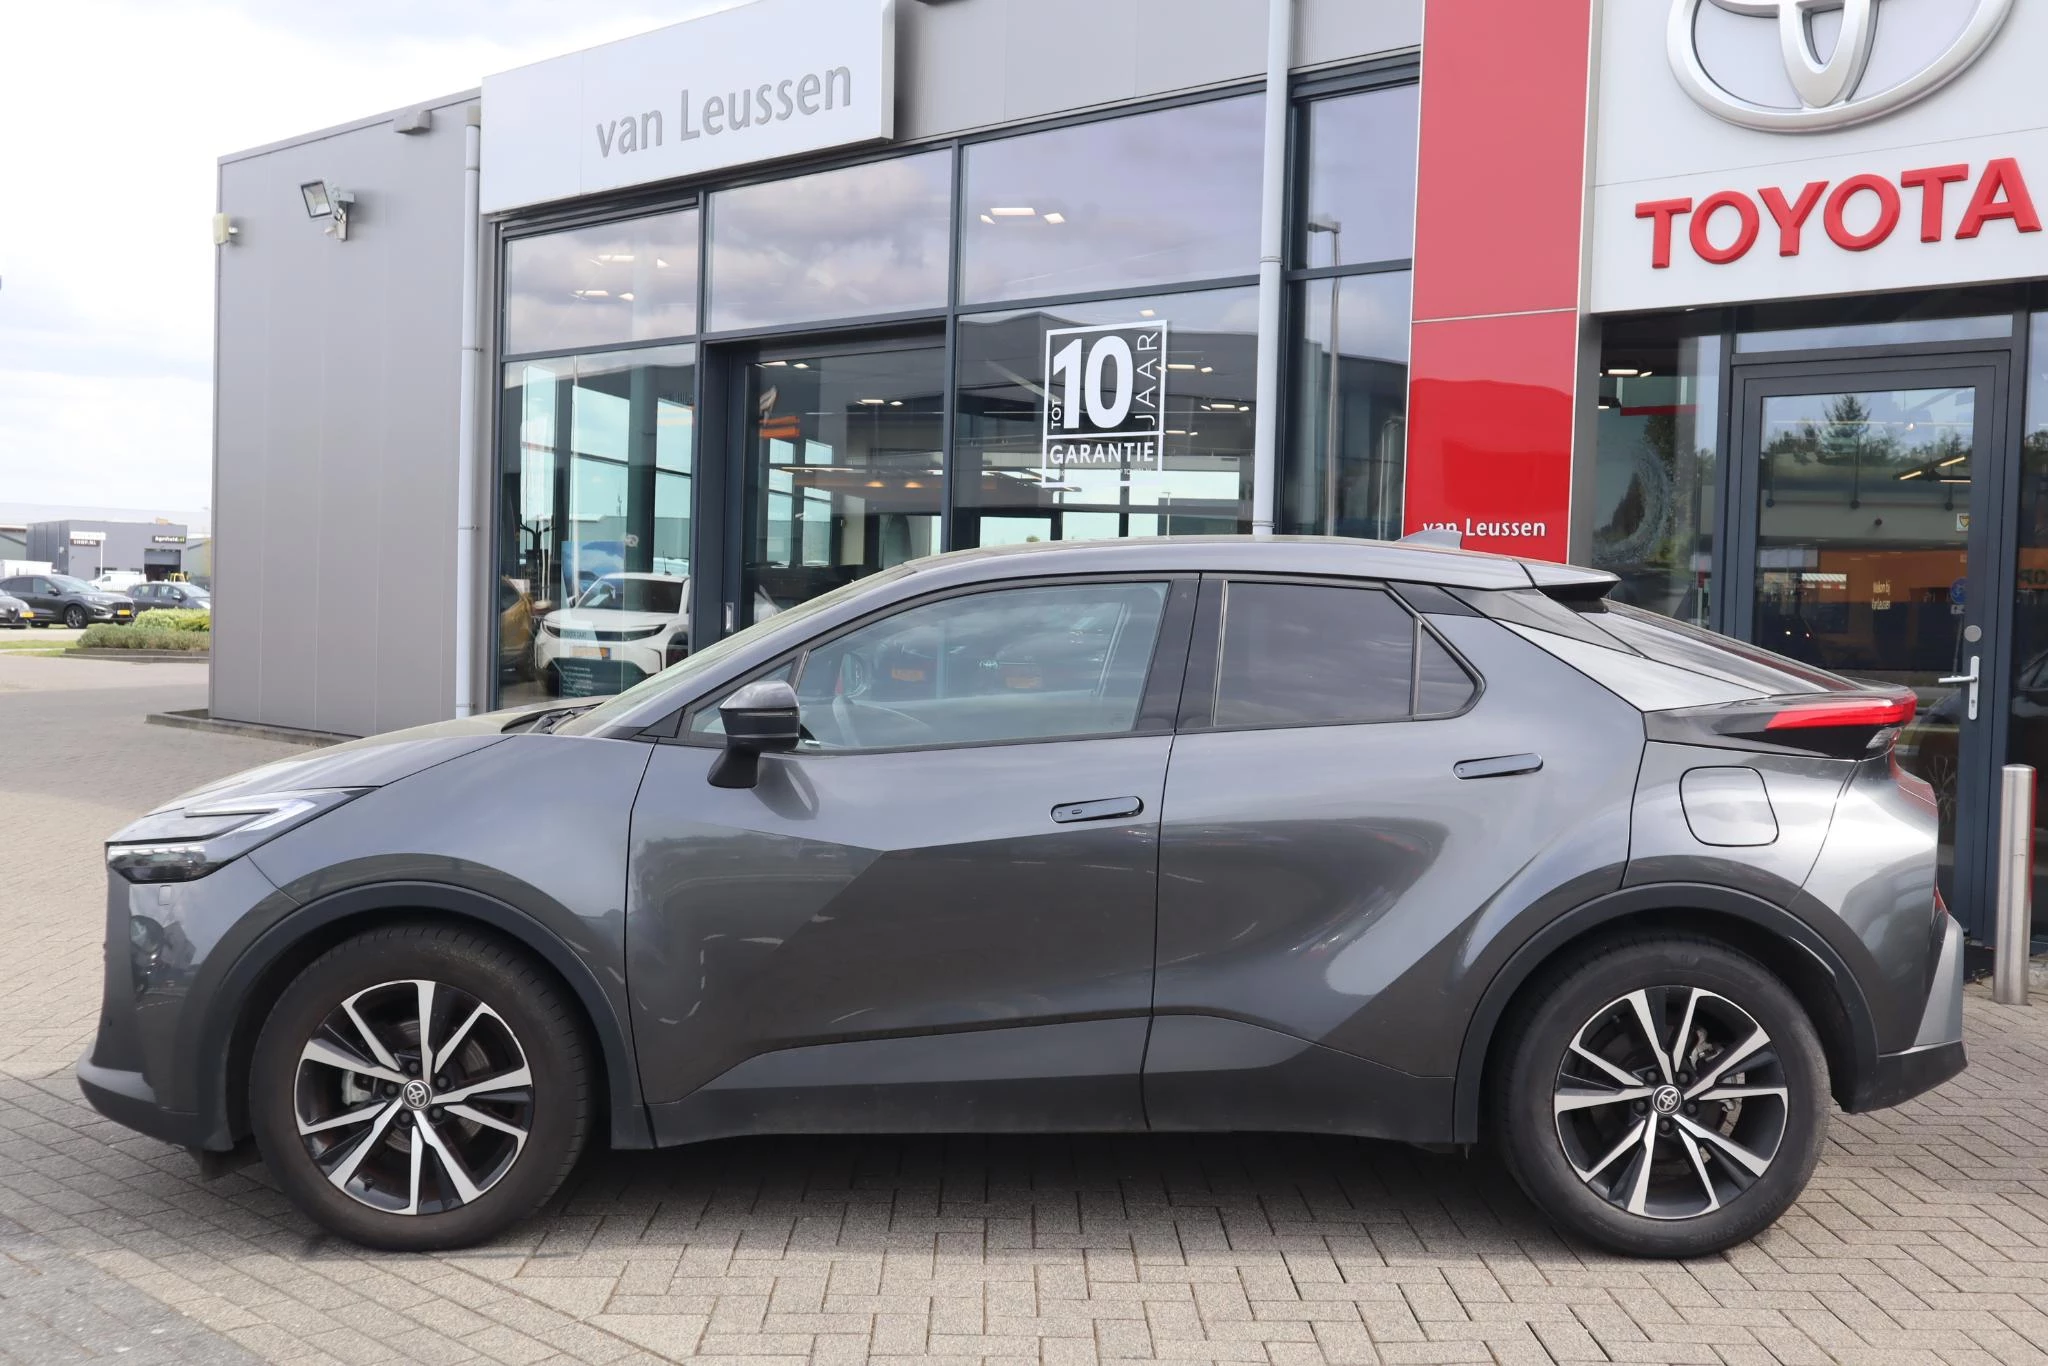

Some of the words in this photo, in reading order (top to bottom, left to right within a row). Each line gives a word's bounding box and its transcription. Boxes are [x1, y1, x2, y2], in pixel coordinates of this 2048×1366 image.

[596, 109, 663, 158] van
[680, 65, 852, 142] Leussen
[1635, 157, 2043, 269] TOYOTA
[1051, 399, 1062, 430] TOT
[1052, 335, 1134, 429] 10
[1134, 332, 1158, 427] JAAR
[1049, 441, 1154, 465] GARANTIE
[1465, 518, 1546, 537] Leussen
